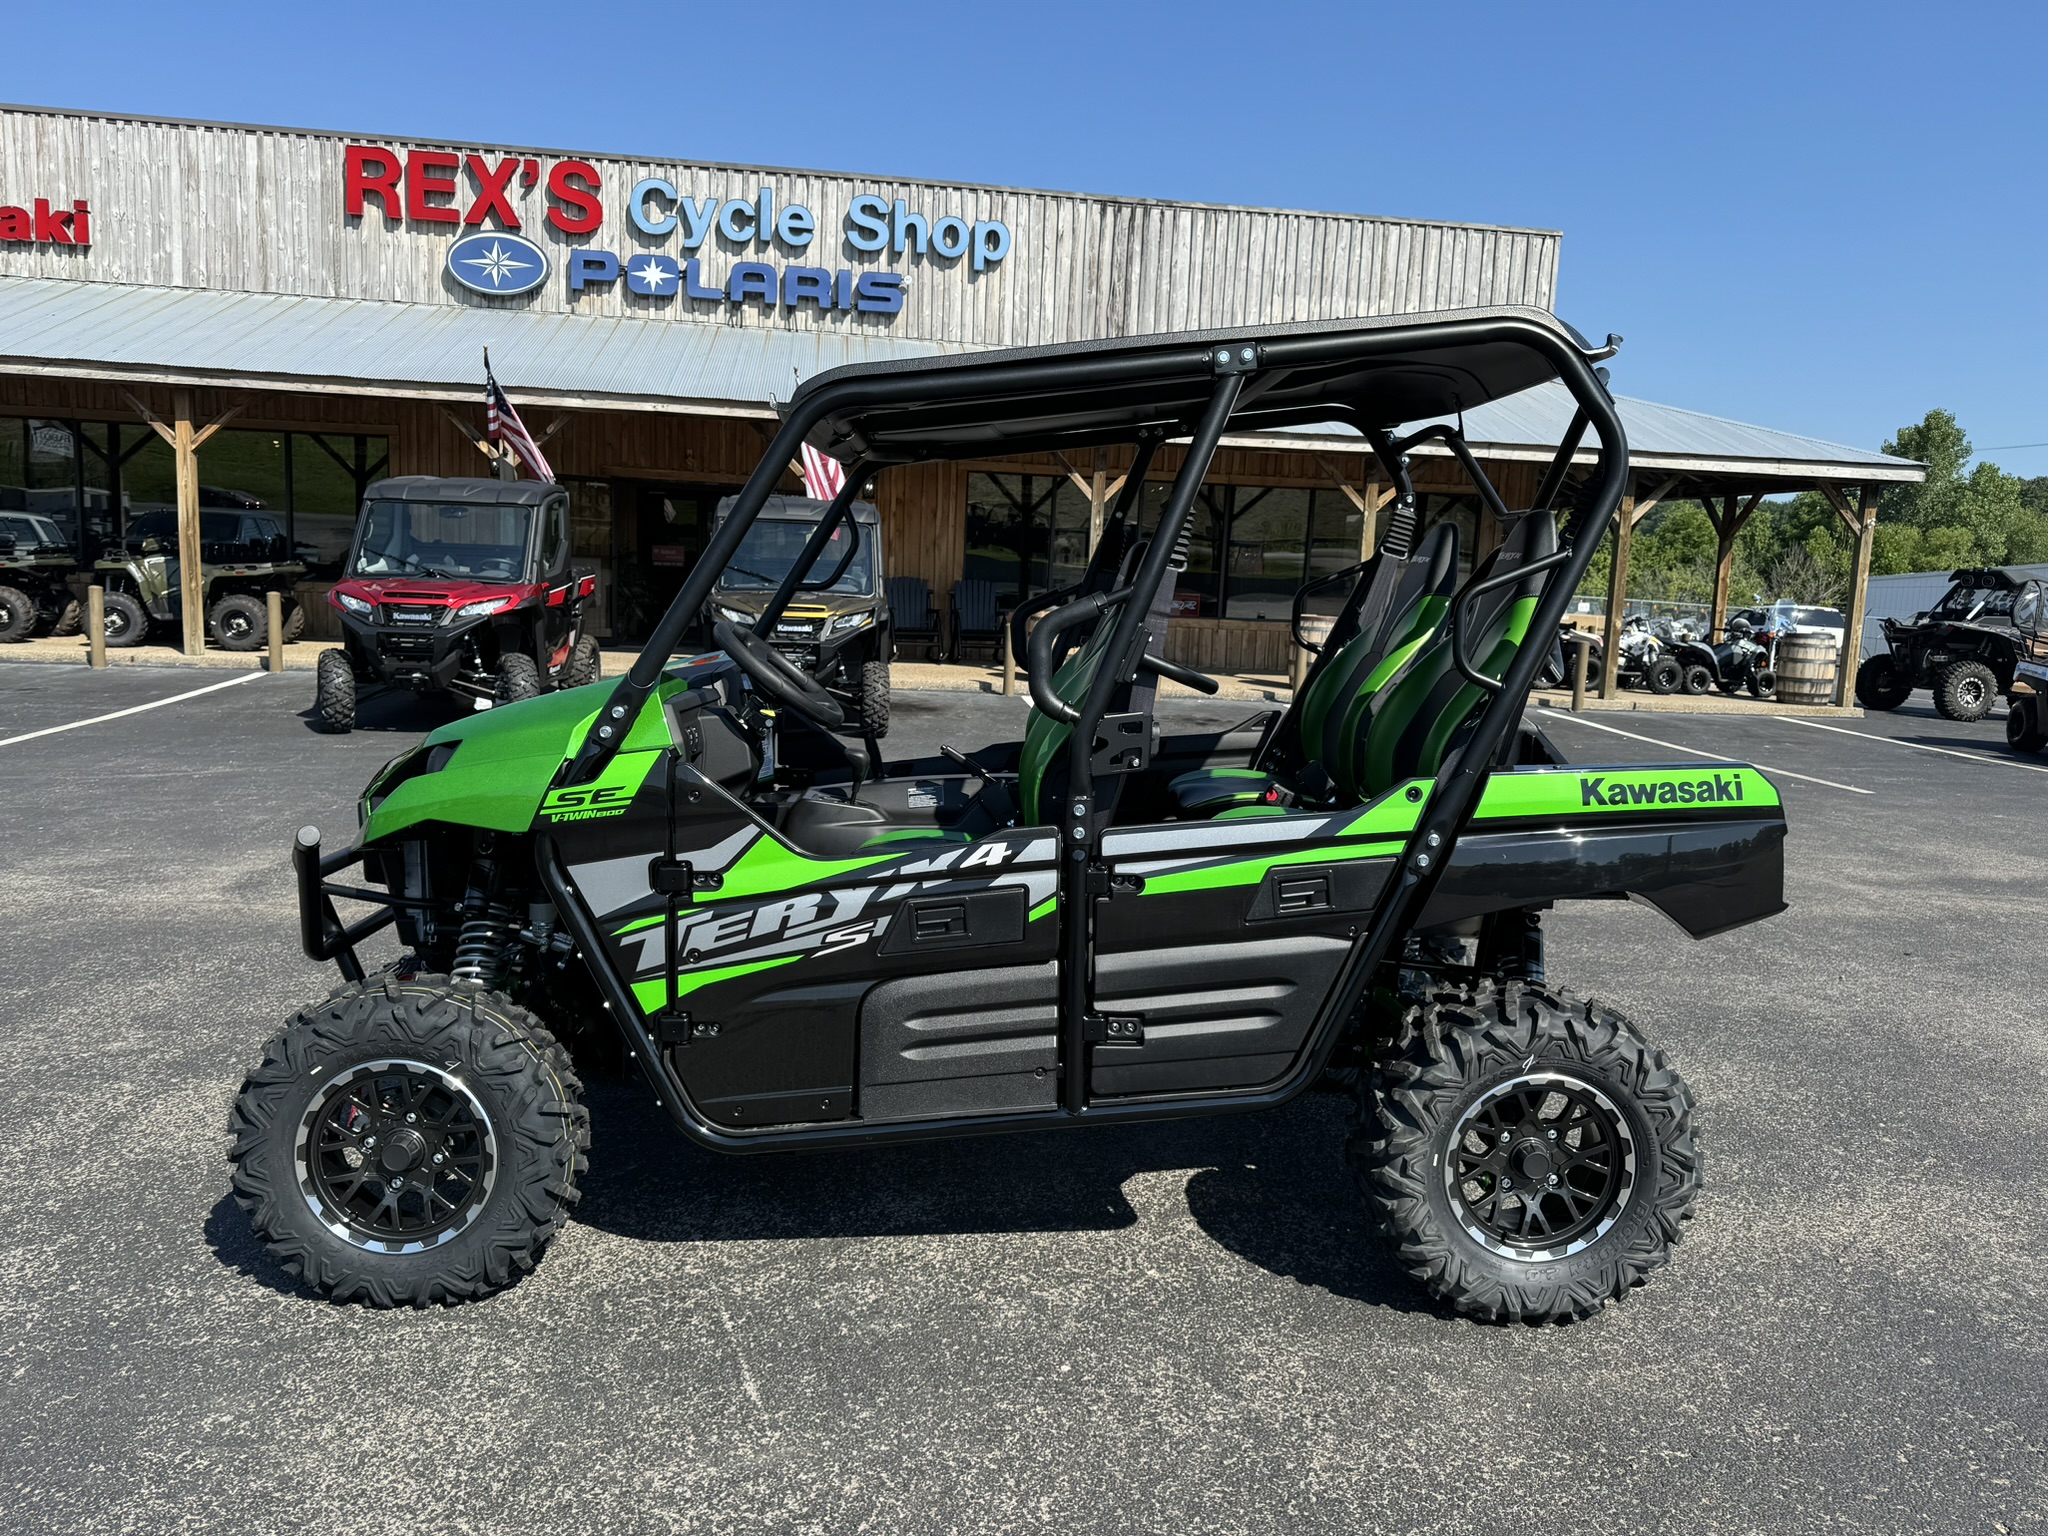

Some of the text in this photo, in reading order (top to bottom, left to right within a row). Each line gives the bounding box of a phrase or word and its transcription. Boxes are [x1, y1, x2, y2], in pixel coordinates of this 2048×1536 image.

[0, 197, 90, 245] aki
[345, 143, 1011, 272] REX'S Cycle Shop
[569, 248, 905, 313] POLARIS
[392, 611, 432, 621] Kawasaki
[777, 623, 813, 632] Kawasaki
[556, 785, 627, 806] SE
[1580, 773, 1744, 807] Kawasaki
